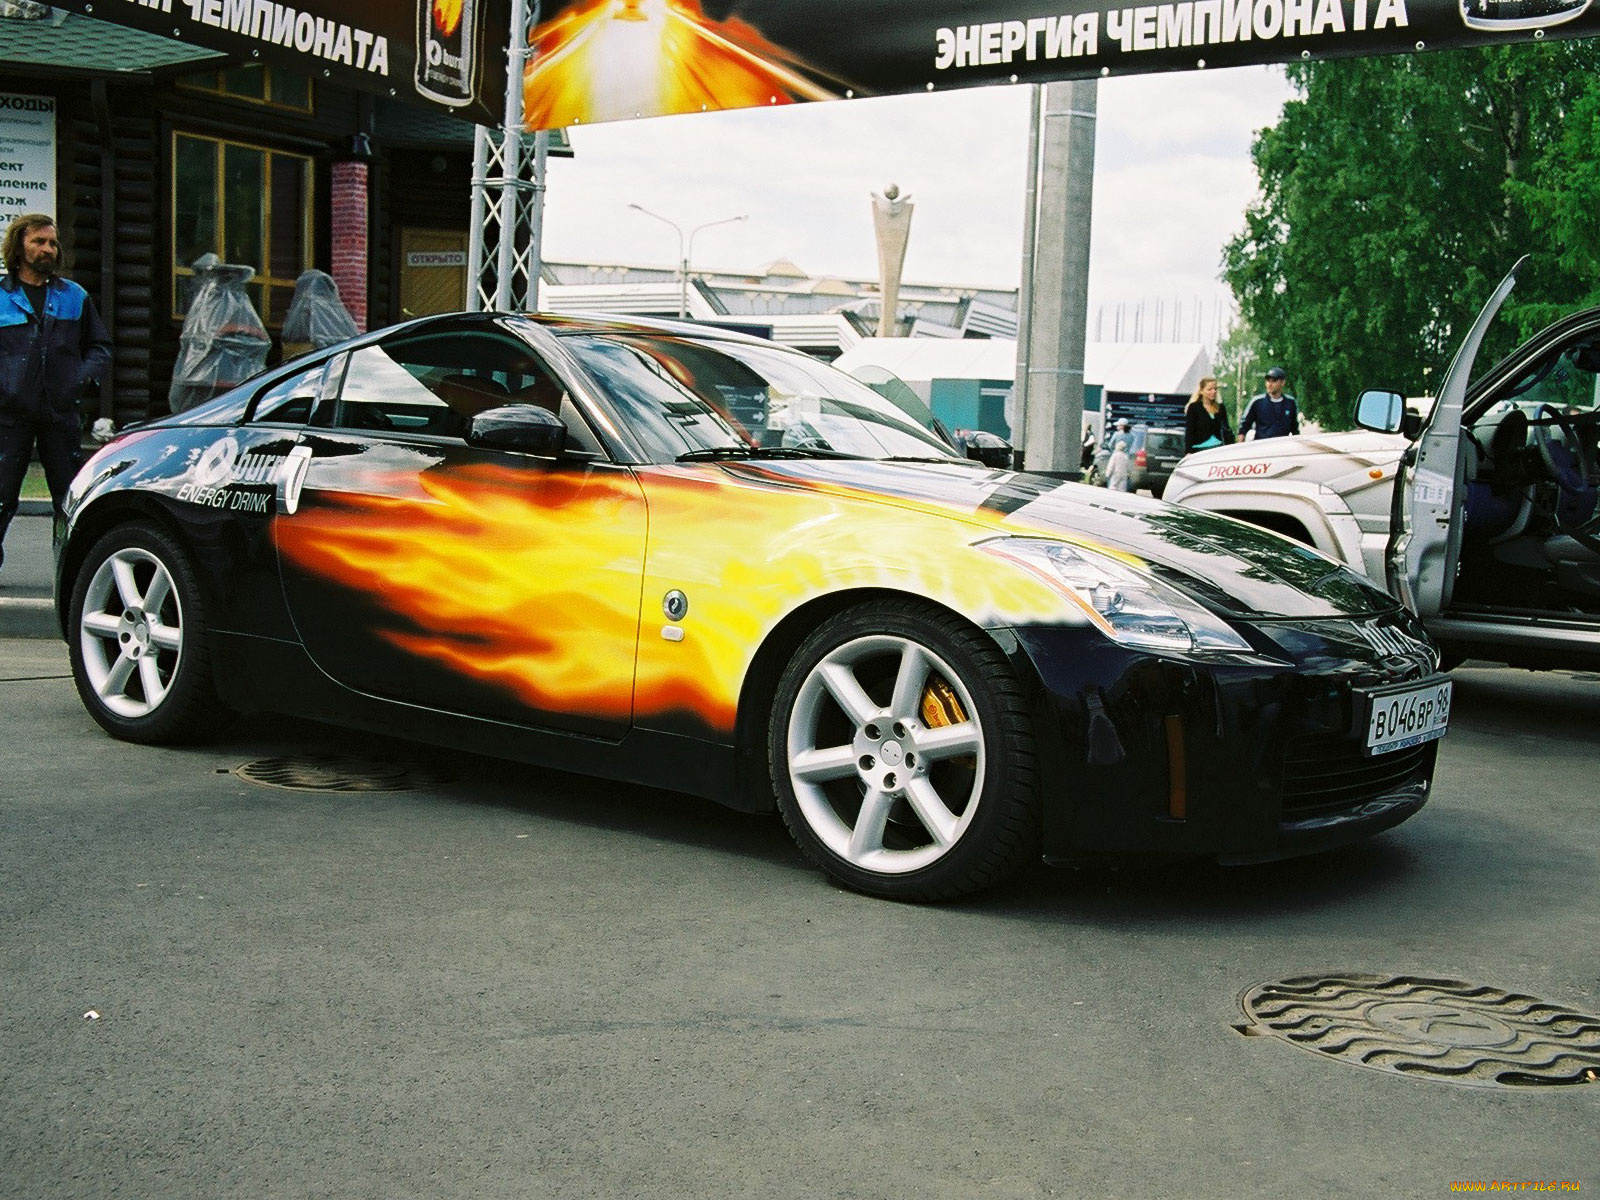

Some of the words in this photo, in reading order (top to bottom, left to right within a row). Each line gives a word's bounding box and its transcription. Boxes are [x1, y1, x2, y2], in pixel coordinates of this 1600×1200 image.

[182, 0, 389, 76] ЧЕМПИОНАТА
[935, 12, 1099, 70] ЭНЕРГИЯ
[1106, 0, 1409, 52] ЧЕМПИОНАТА
[410, 254, 463, 264] ОТКРЫТО
[1207, 463, 1272, 478] PROLOGY
[176, 482, 231, 508] ENERGY
[230, 490, 272, 513] DRINK
